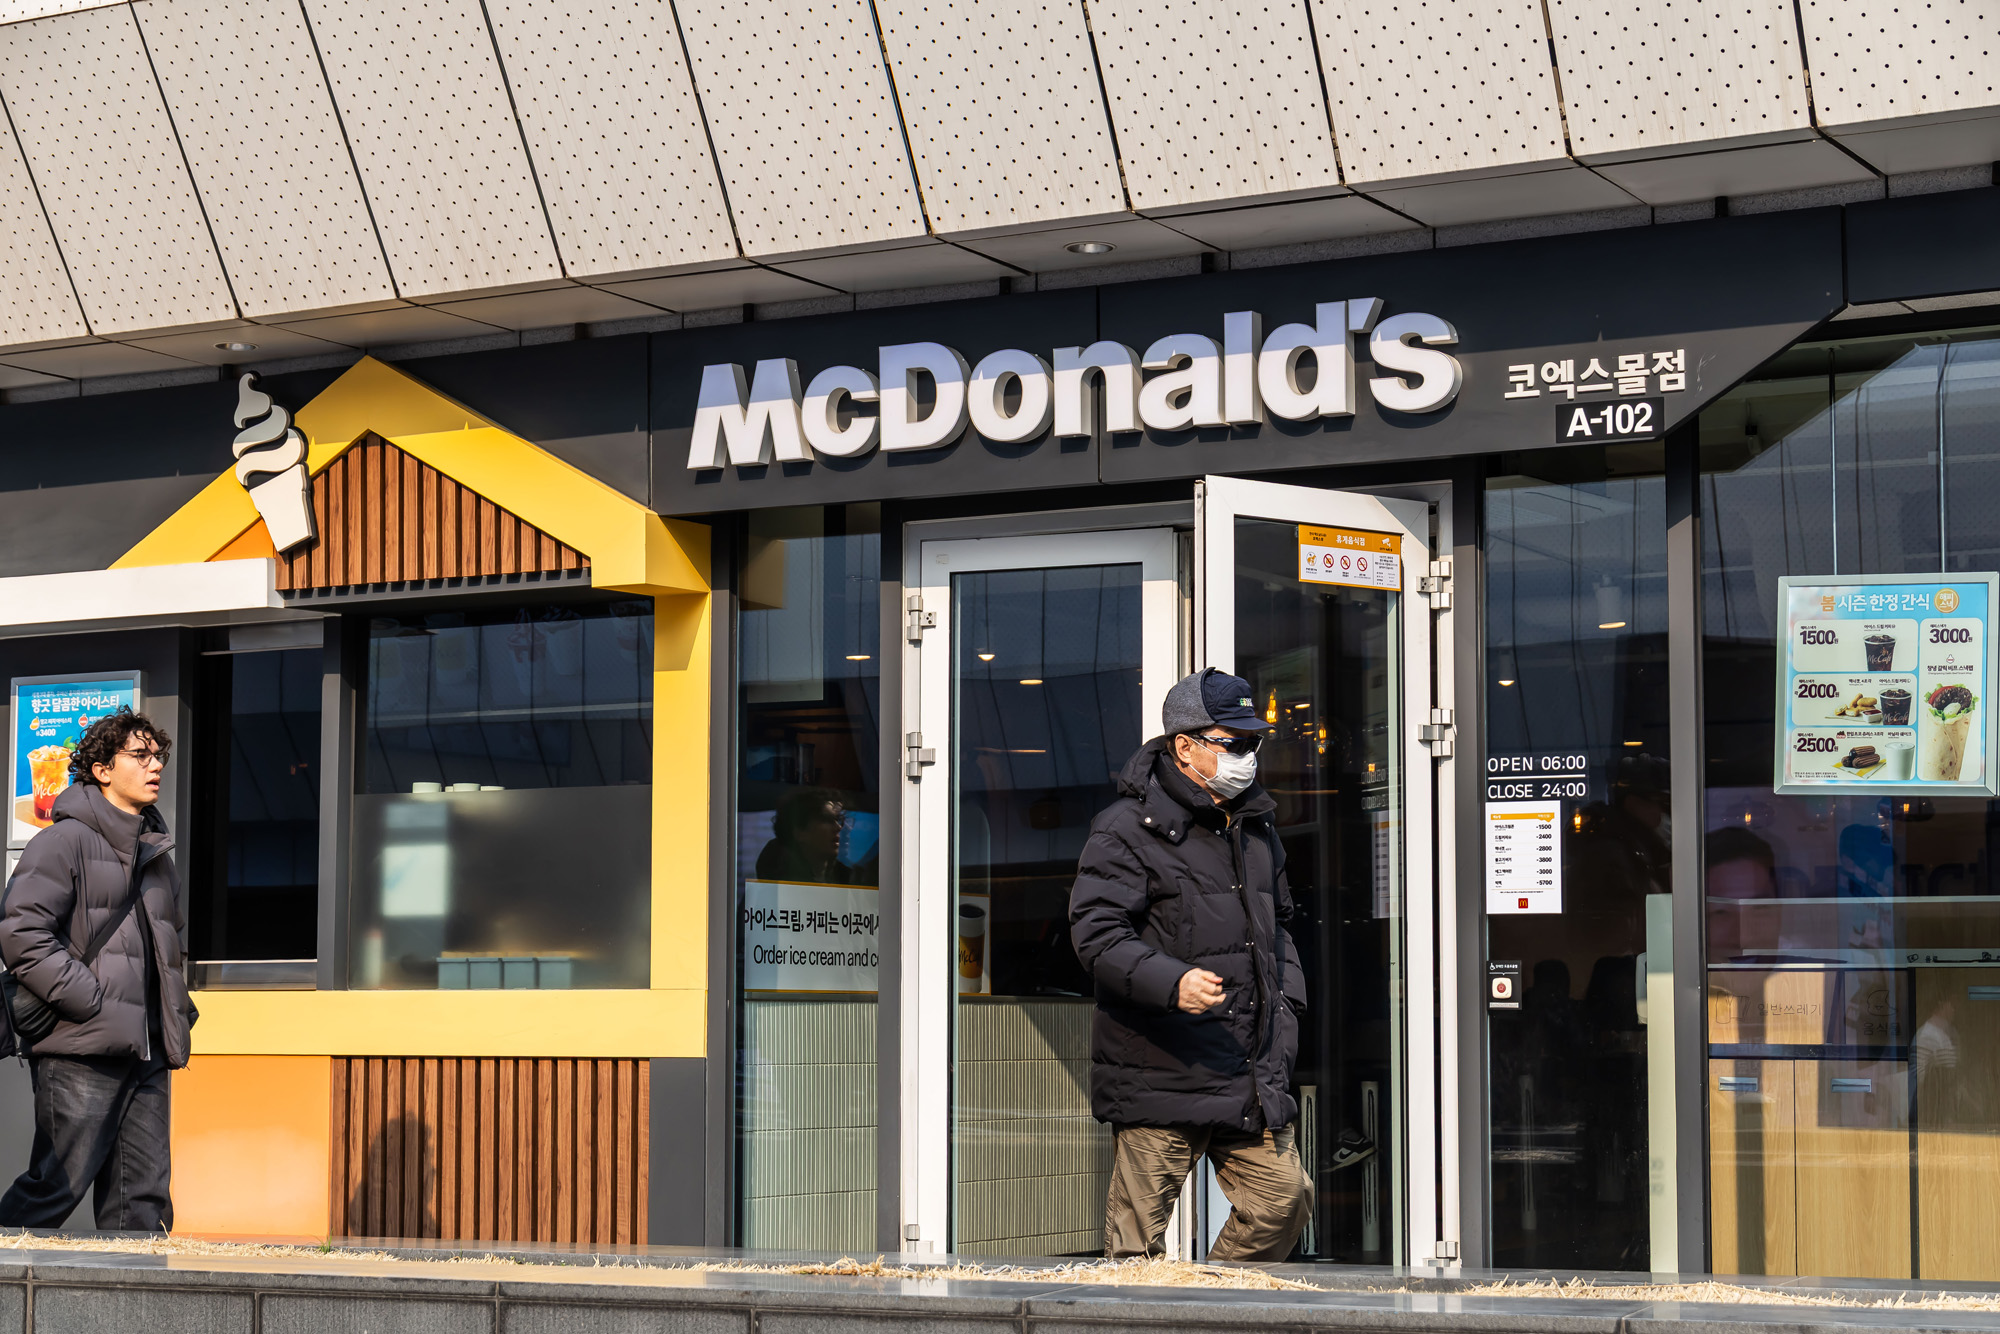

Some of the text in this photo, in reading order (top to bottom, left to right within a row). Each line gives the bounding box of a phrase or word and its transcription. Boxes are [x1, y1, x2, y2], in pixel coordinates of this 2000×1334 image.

[687, 297, 1463, 470] McDonald's
[1504, 349, 1686, 401] 코엑스몰점
[1566, 402, 1653, 438] A-102
[1820, 593, 1930, 612] 봄 시즌 한정 간식
[31, 694, 119, 713] 향긋 달콤한 아이스티
[1487, 755, 1586, 772] OPEN 06:00
[1487, 782, 1586, 799] CLOSE 24:00
[806, 911, 840, 934] 커피는
[753, 945, 787, 964] Order
[789, 945, 807, 965] ice
[808, 950, 846, 966] cream
[847, 948, 869, 967] and
[1757, 1003, 1822, 1016] 일반쓰레기
